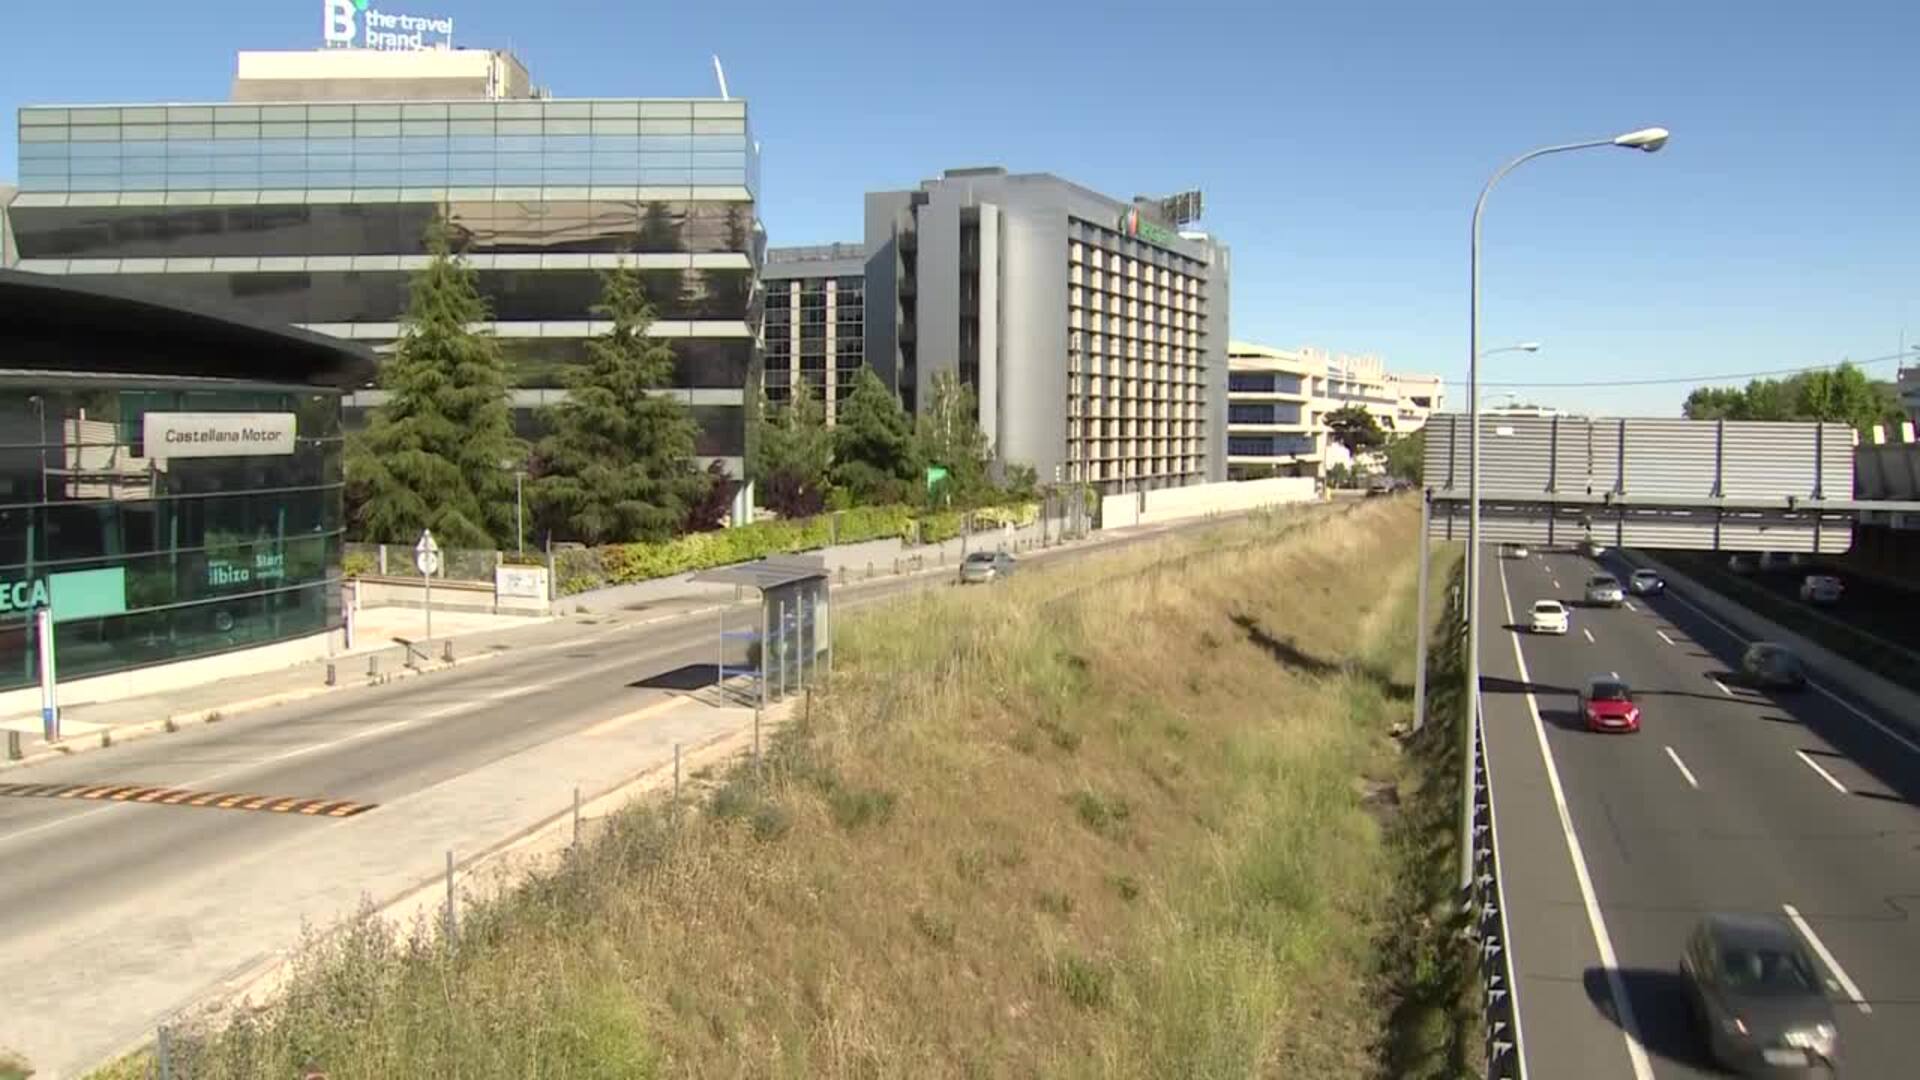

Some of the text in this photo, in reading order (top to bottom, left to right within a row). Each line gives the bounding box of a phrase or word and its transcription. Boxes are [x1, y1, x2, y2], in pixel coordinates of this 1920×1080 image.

[324, 0, 356, 41] B
[365, 9, 453, 34] the travel
[365, 27, 422, 48] brand
[166, 428, 282, 443] Castellana Motor
[0, 579, 49, 610] ECA
